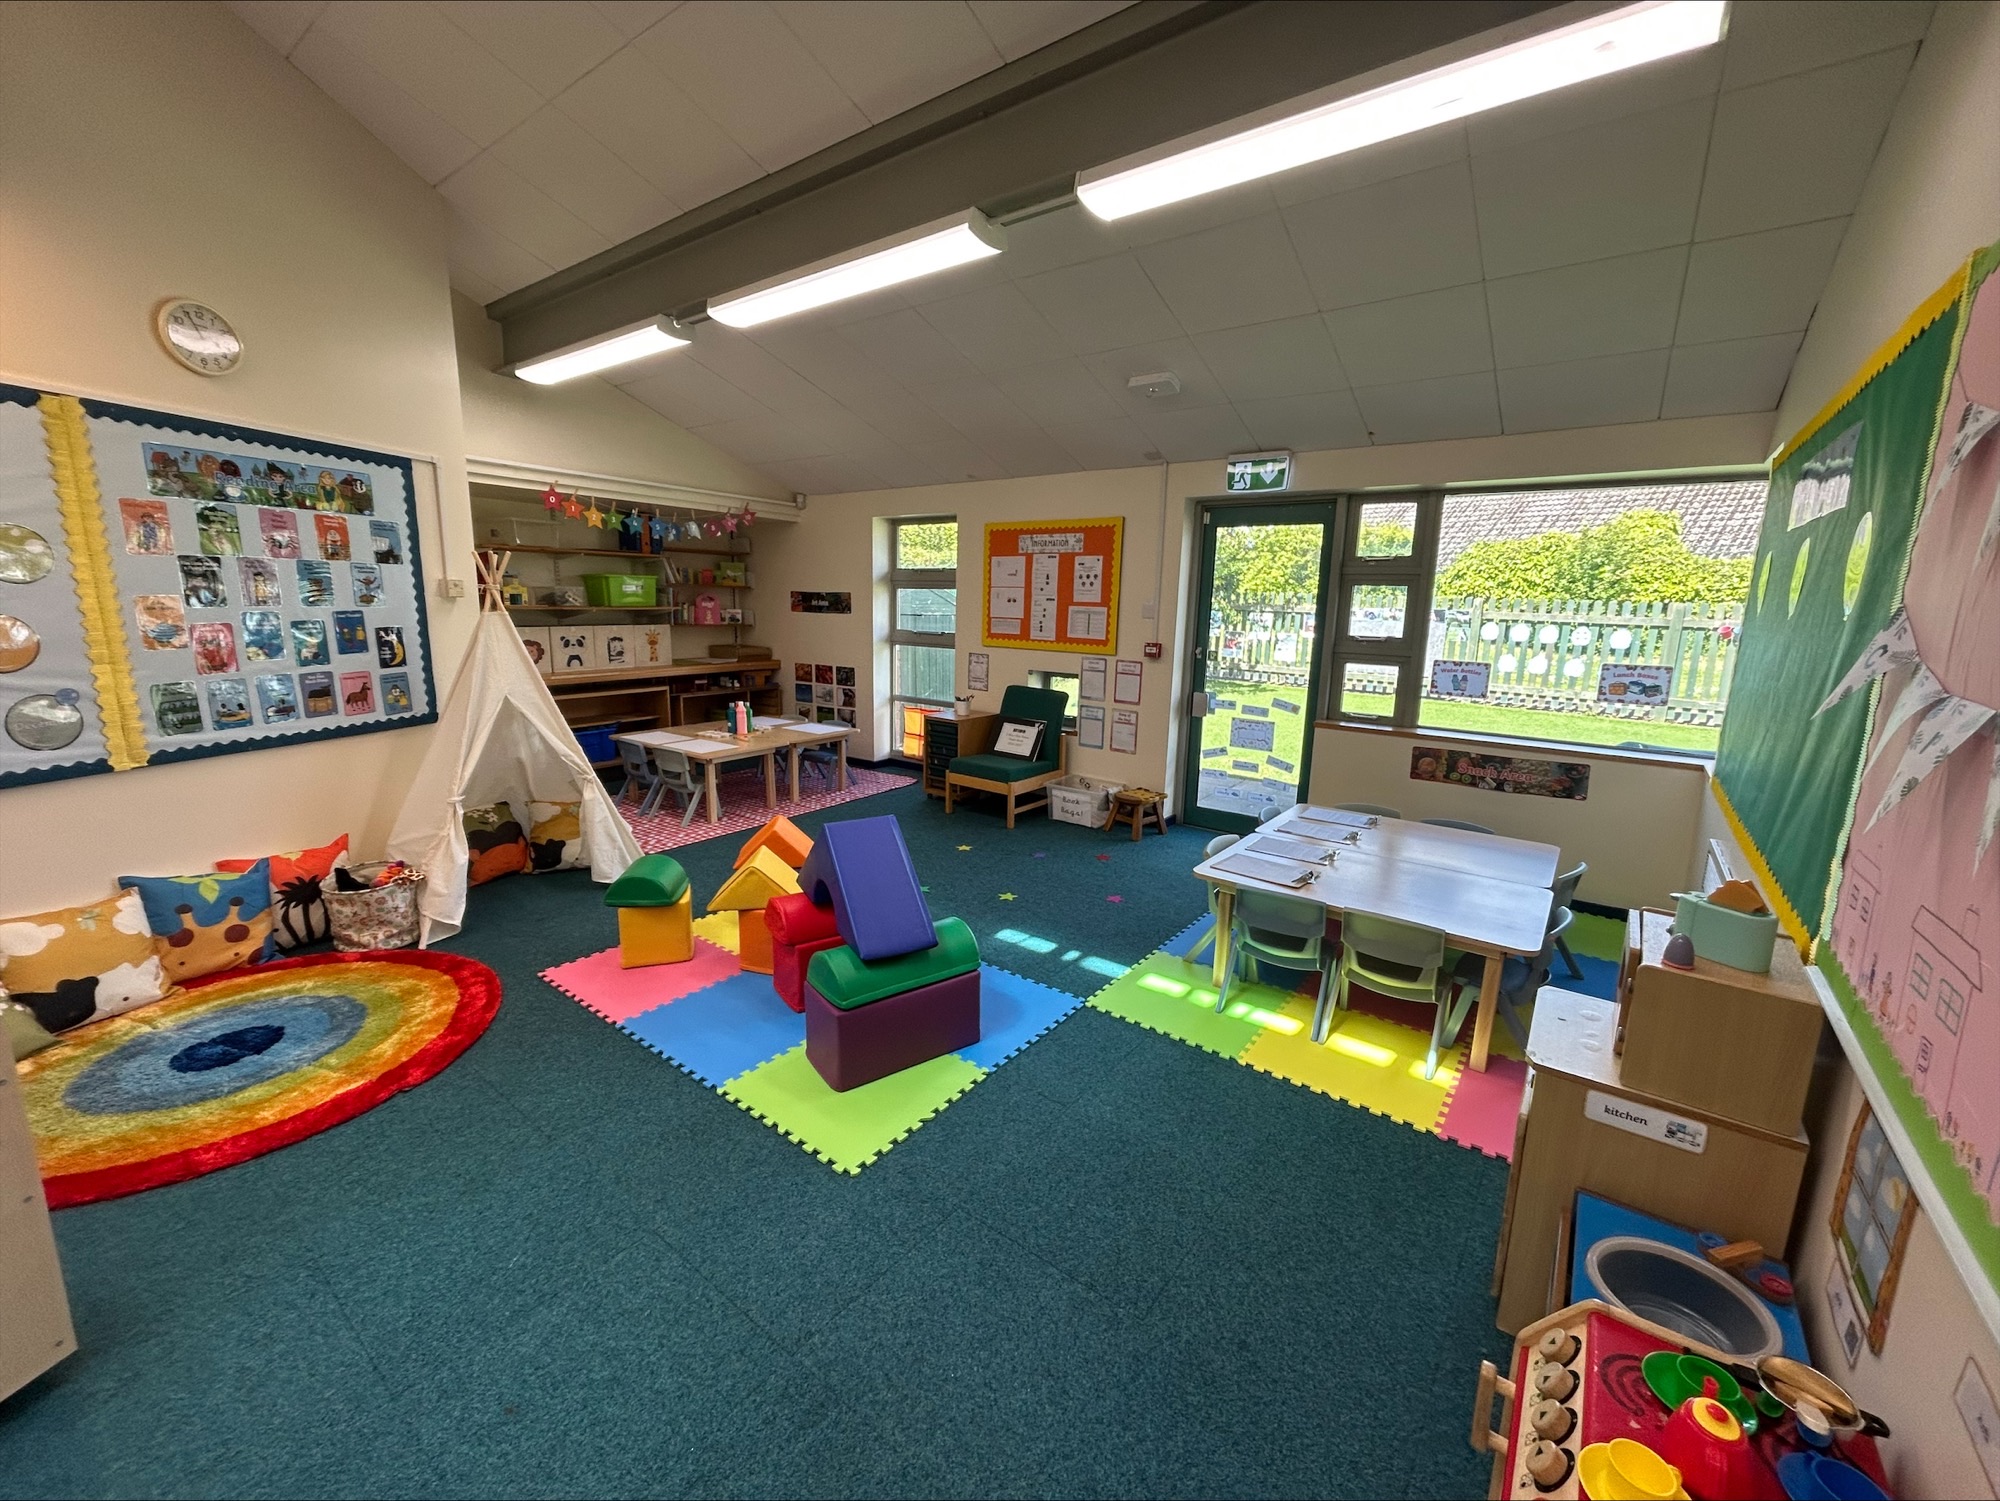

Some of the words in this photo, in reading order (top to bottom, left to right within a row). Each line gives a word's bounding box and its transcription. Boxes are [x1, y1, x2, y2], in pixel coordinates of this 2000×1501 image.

[214, 471, 280, 494] Reading
[284, 479, 317, 494] Area
[549, 495, 556, 504] 0
[591, 513, 597, 521] 2
[1031, 539, 1070, 548] INFORMATION
[1864, 643, 1889, 670] C
[1460, 667, 1482, 676] Bottles
[1637, 672, 1659, 680] Boxes
[1457, 761, 1499, 780] Snack
[1500, 767, 1535, 783] Area
[1062, 796, 1081, 806] Book
[1603, 1104, 1649, 1126] kitchen
